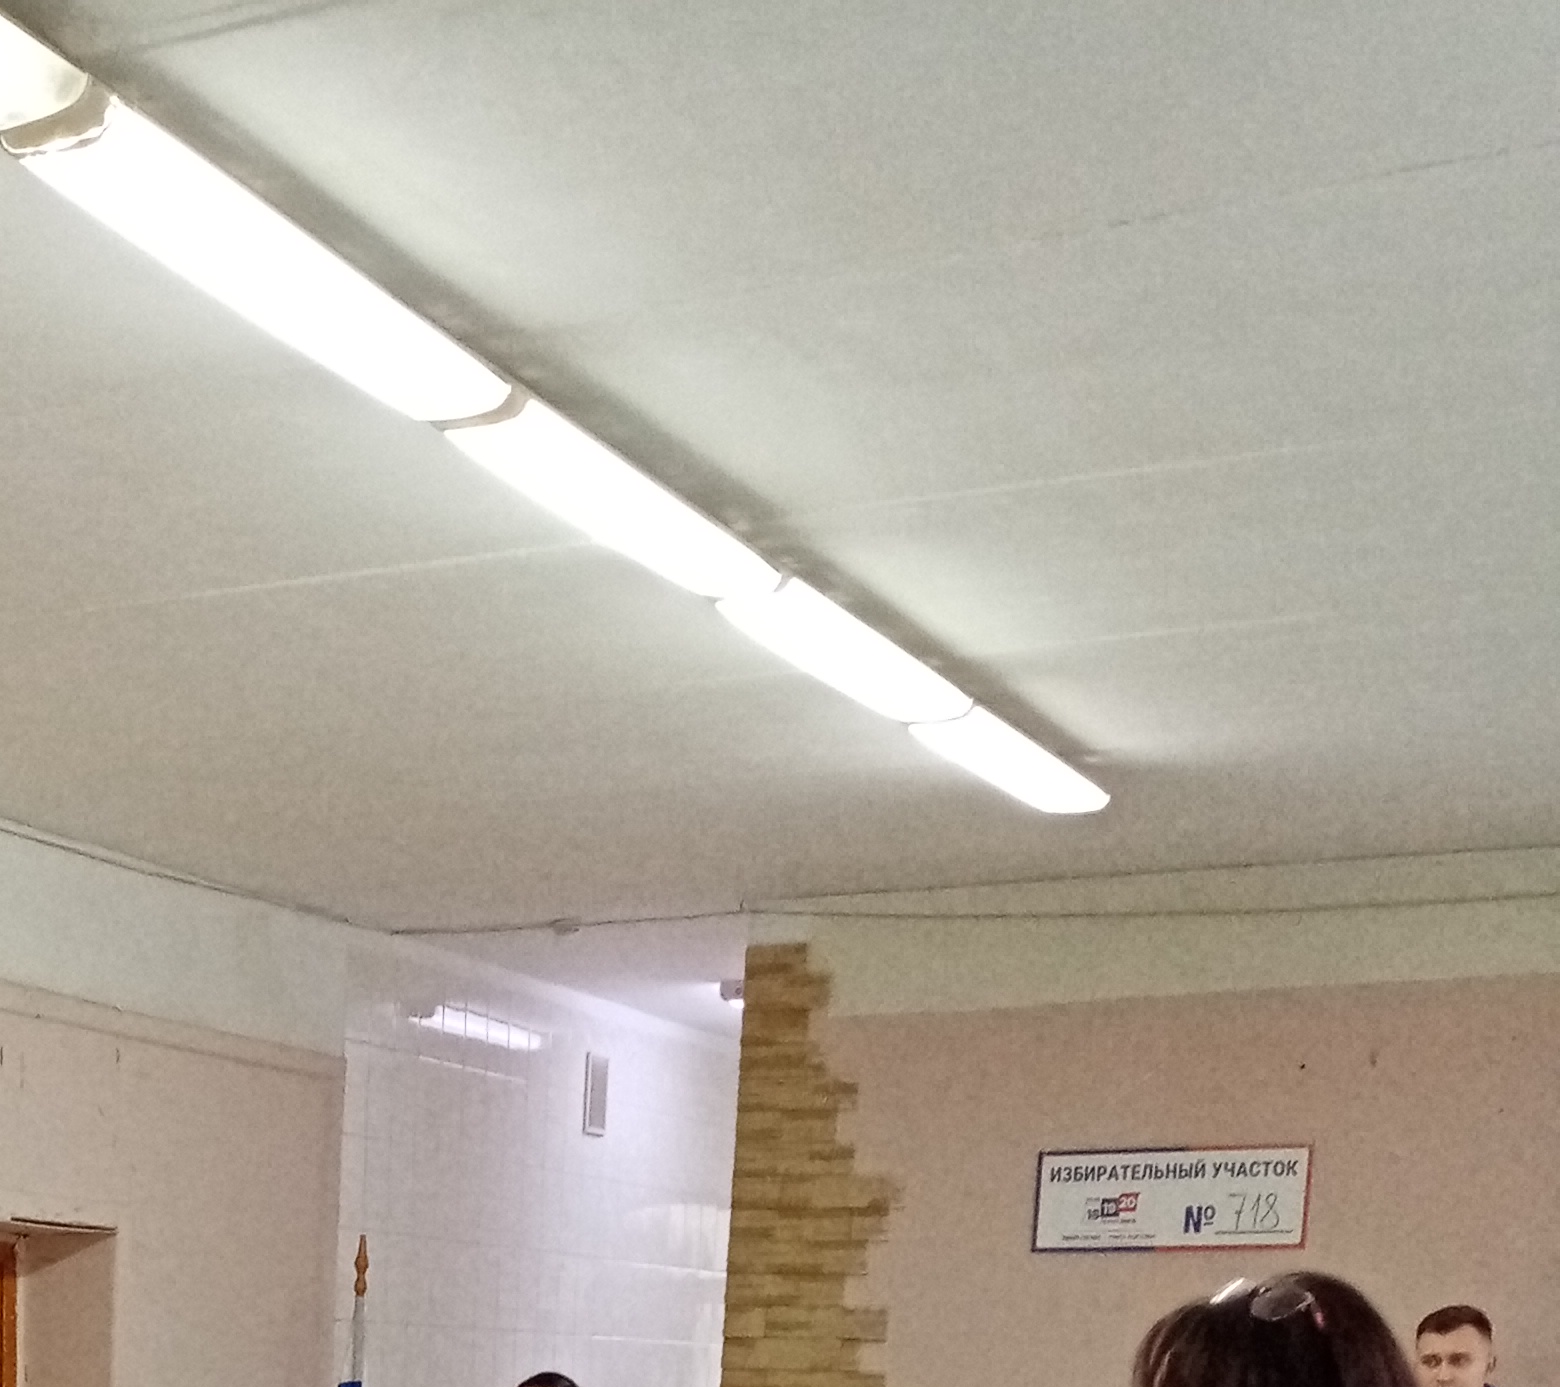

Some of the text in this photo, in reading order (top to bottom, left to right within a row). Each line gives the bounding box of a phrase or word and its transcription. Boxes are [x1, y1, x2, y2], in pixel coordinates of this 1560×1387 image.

[1049, 1159, 1298, 1183] ИЗБИРАТЕЛЬНЫЙ УЧАСТОК
[1119, 1196, 1137, 1209] 20
[1184, 1192, 1280, 1234] № 718
